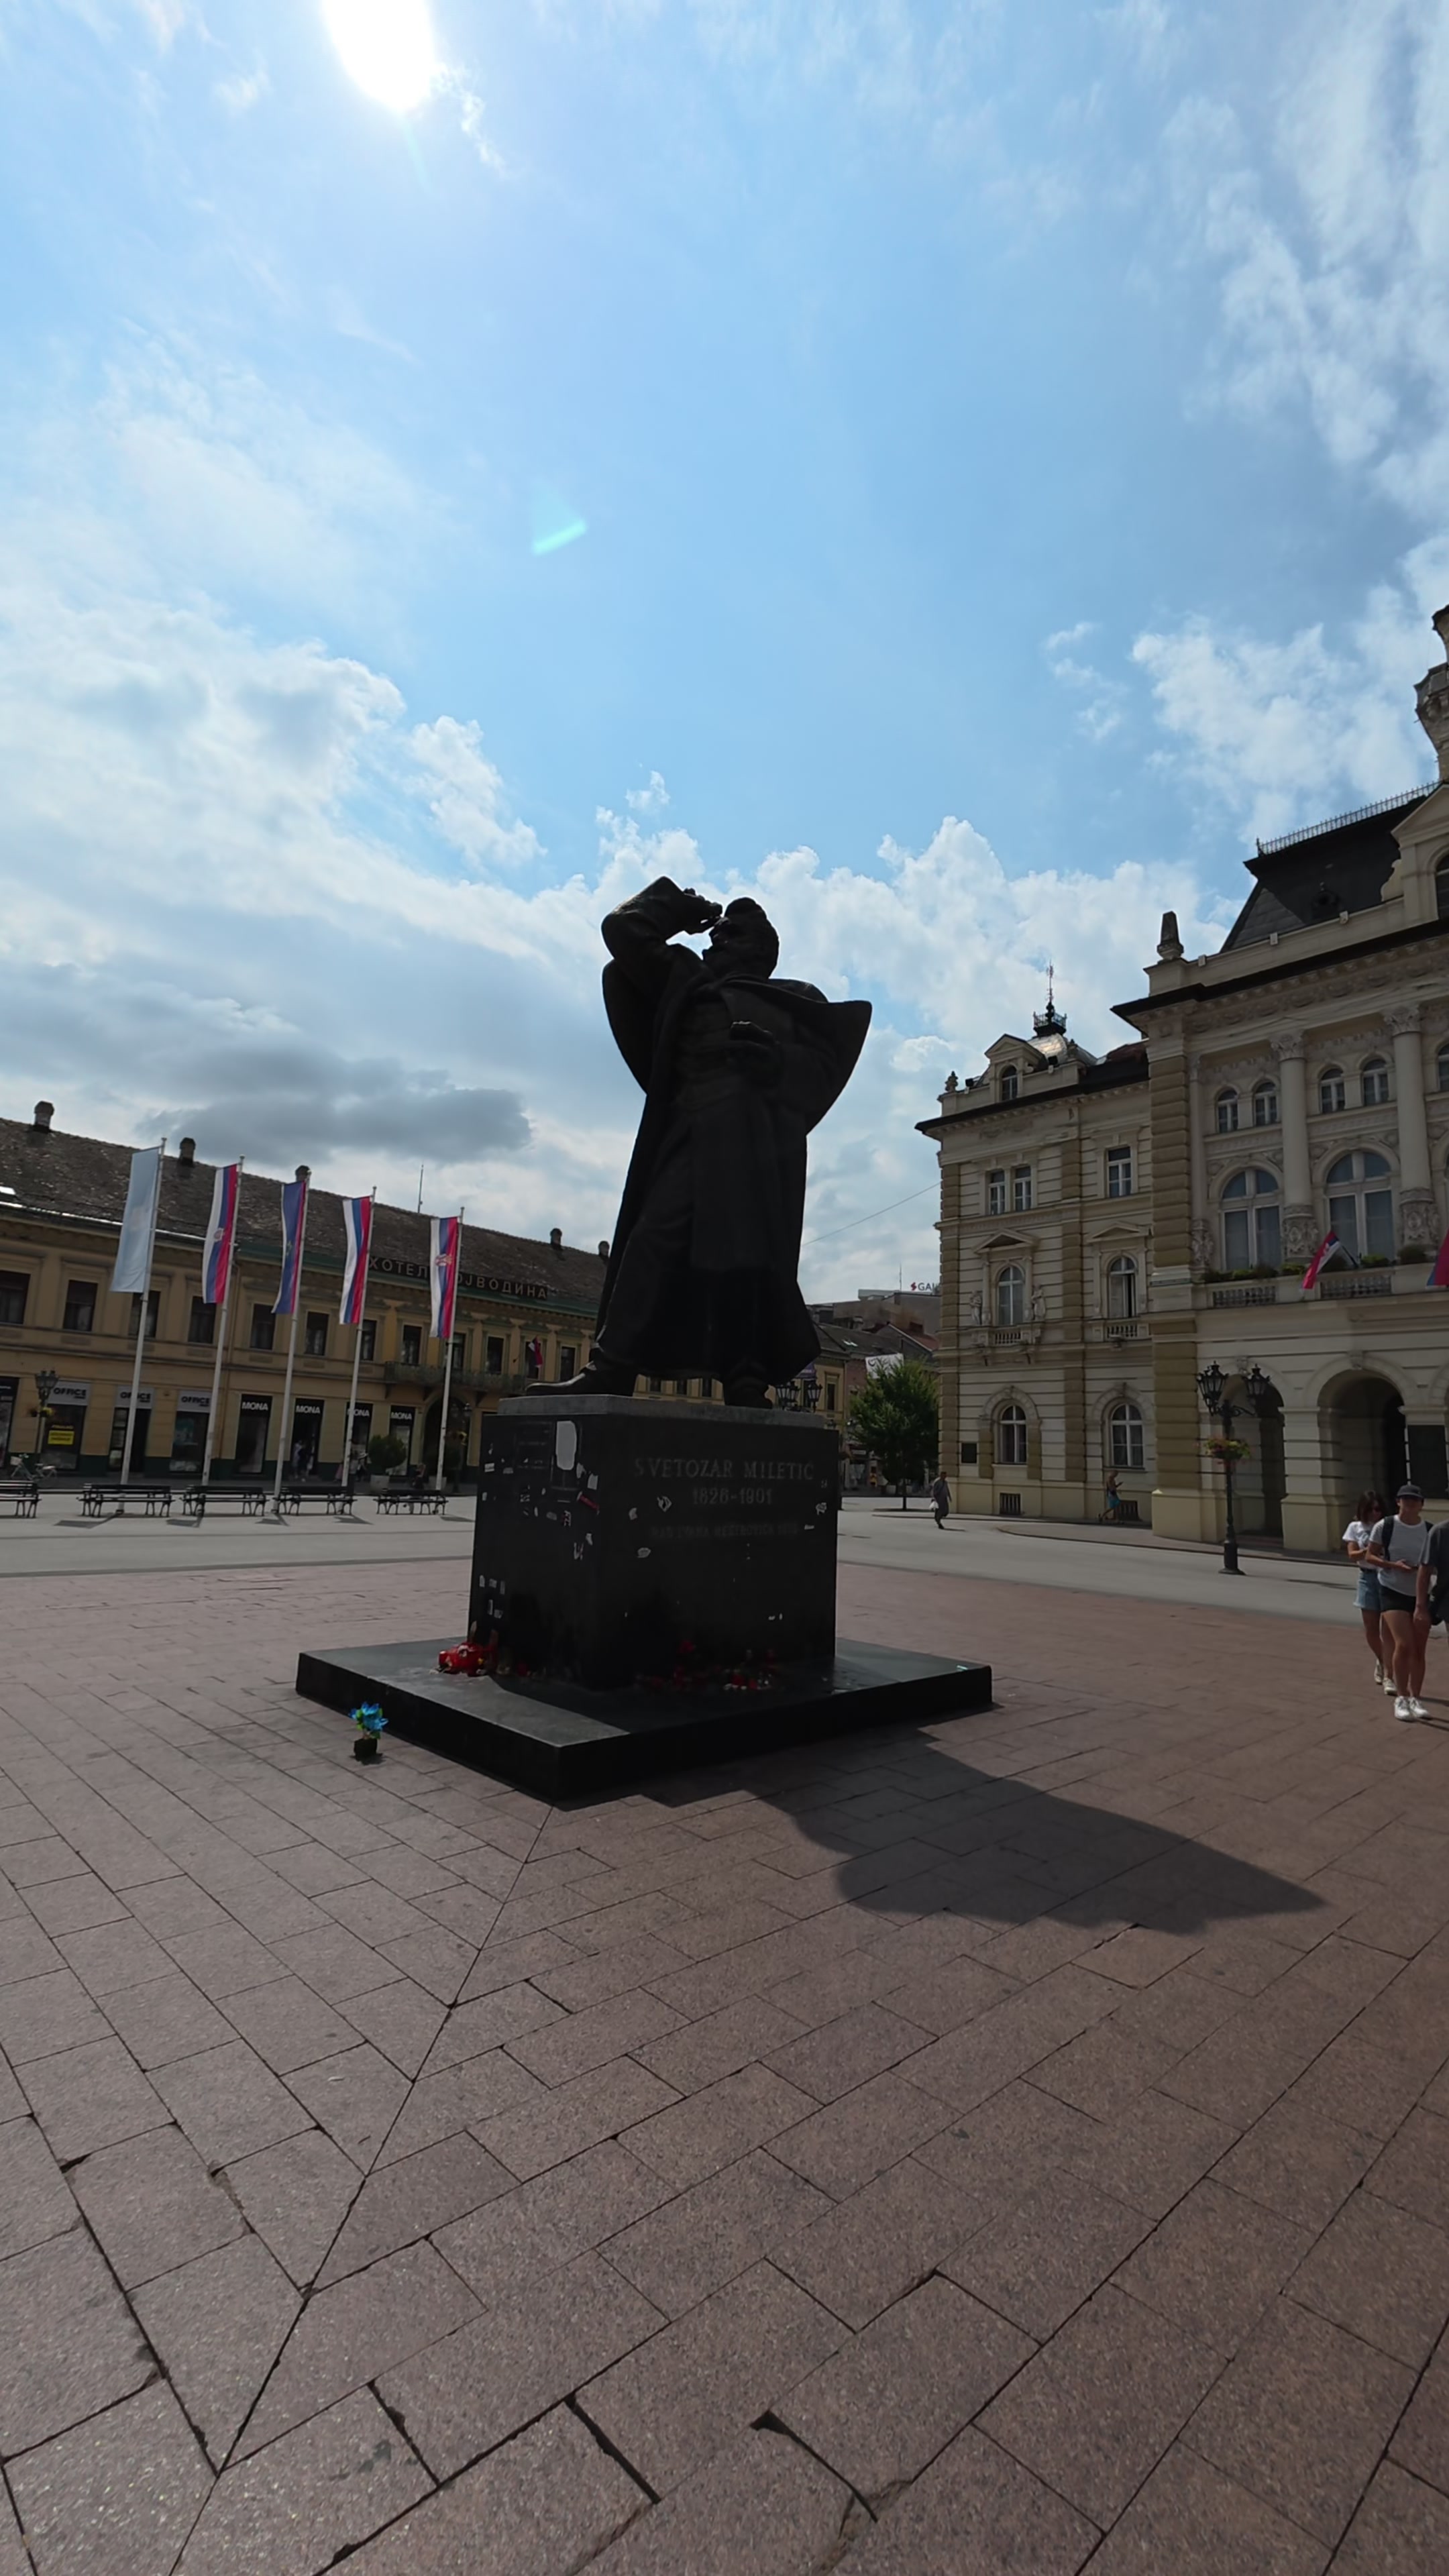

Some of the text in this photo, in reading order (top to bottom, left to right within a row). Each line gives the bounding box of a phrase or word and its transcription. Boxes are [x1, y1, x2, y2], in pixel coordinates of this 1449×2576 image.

[370, 1257, 427, 1278] ХОТЕЛ
[54, 1387, 86, 1396] OFFICE
[182, 1396, 209, 1404] OFFICE
[241, 1401, 268, 1411] MONA
[296, 1405, 321, 1414] MONA
[391, 1411, 413, 1419] MONA
[634, 1458, 733, 1478] SVETOZAR
